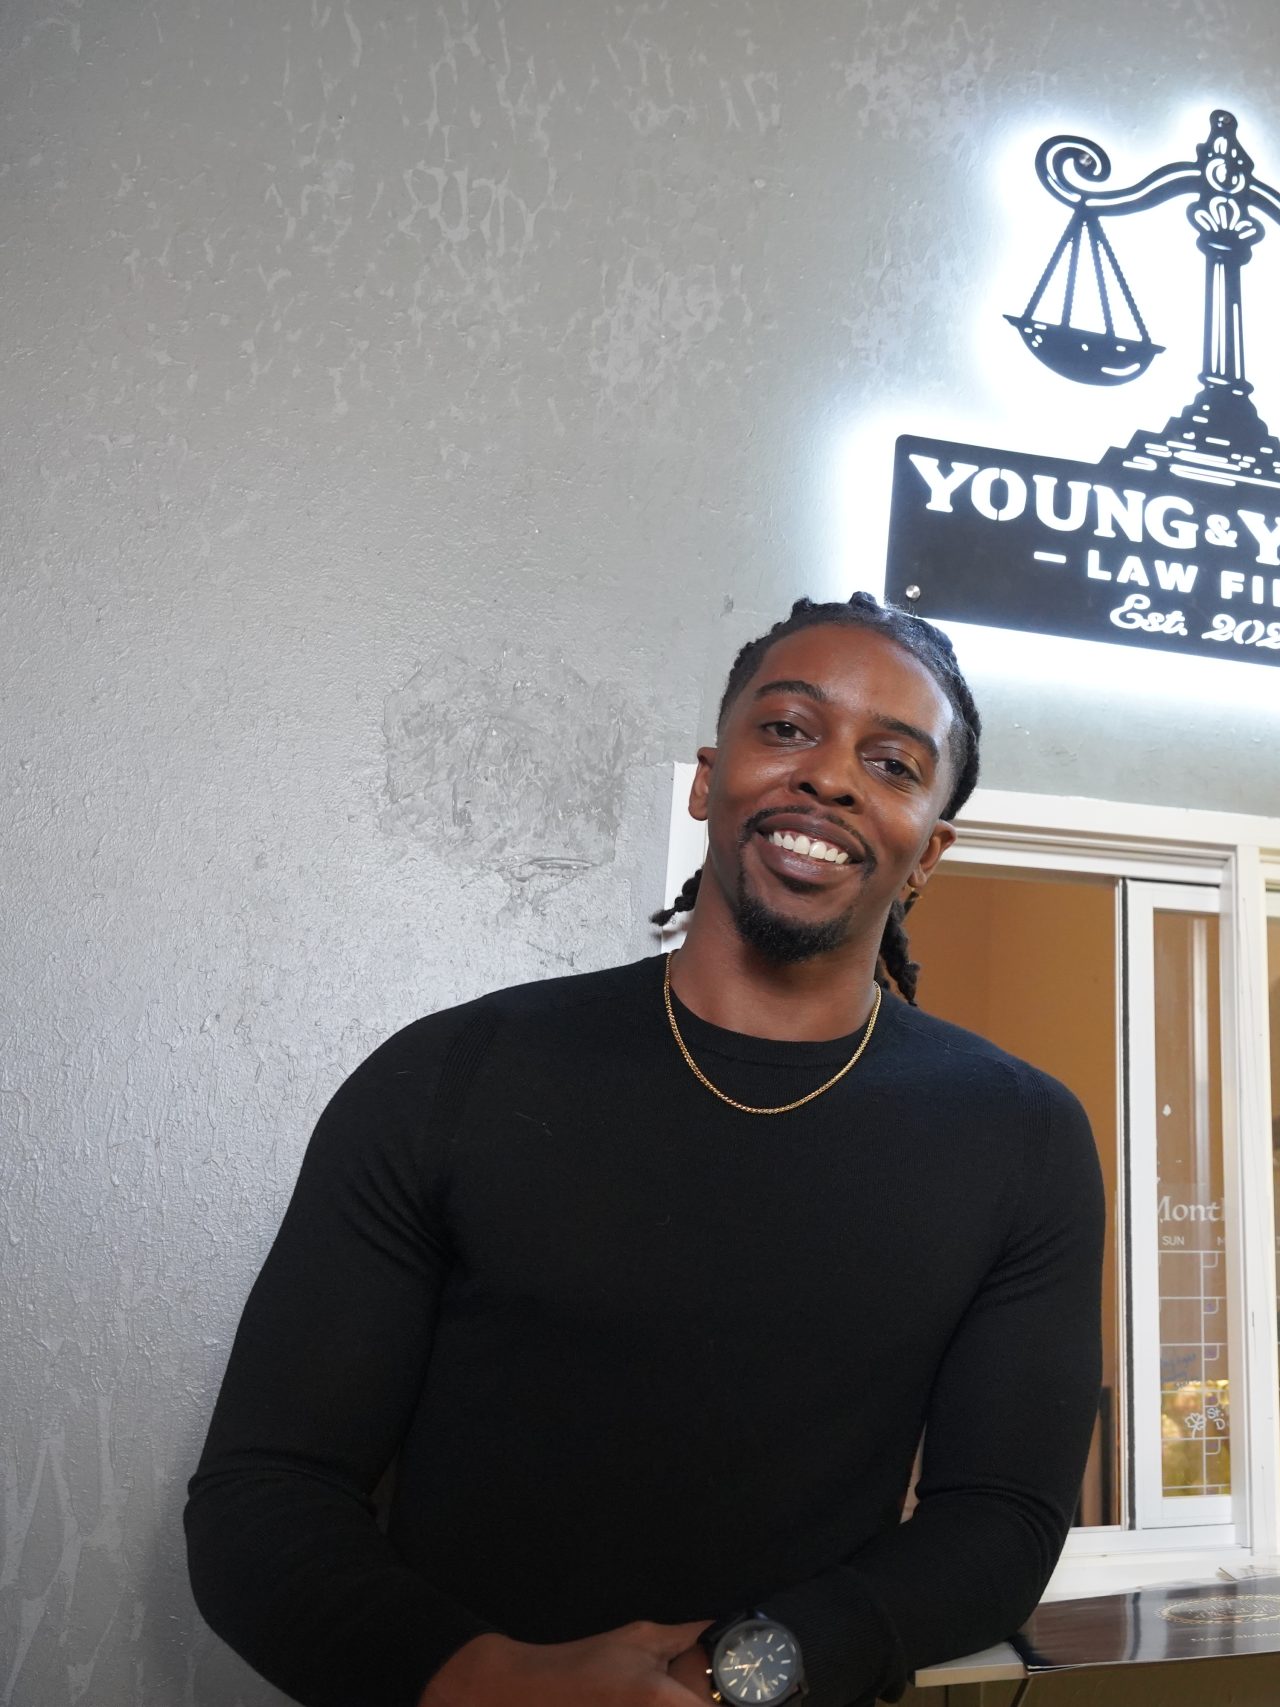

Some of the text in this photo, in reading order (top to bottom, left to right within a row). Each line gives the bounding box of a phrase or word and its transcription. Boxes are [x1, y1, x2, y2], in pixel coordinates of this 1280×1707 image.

[908, 453, 1199, 549] YOUNG
[1204, 514, 1238, 548] &
[1087, 549, 1199, 593] LAW
[1109, 593, 1188, 636] Est.
[1157, 1194, 1225, 1223] Mont
[1162, 1235, 1185, 1247] SUN
